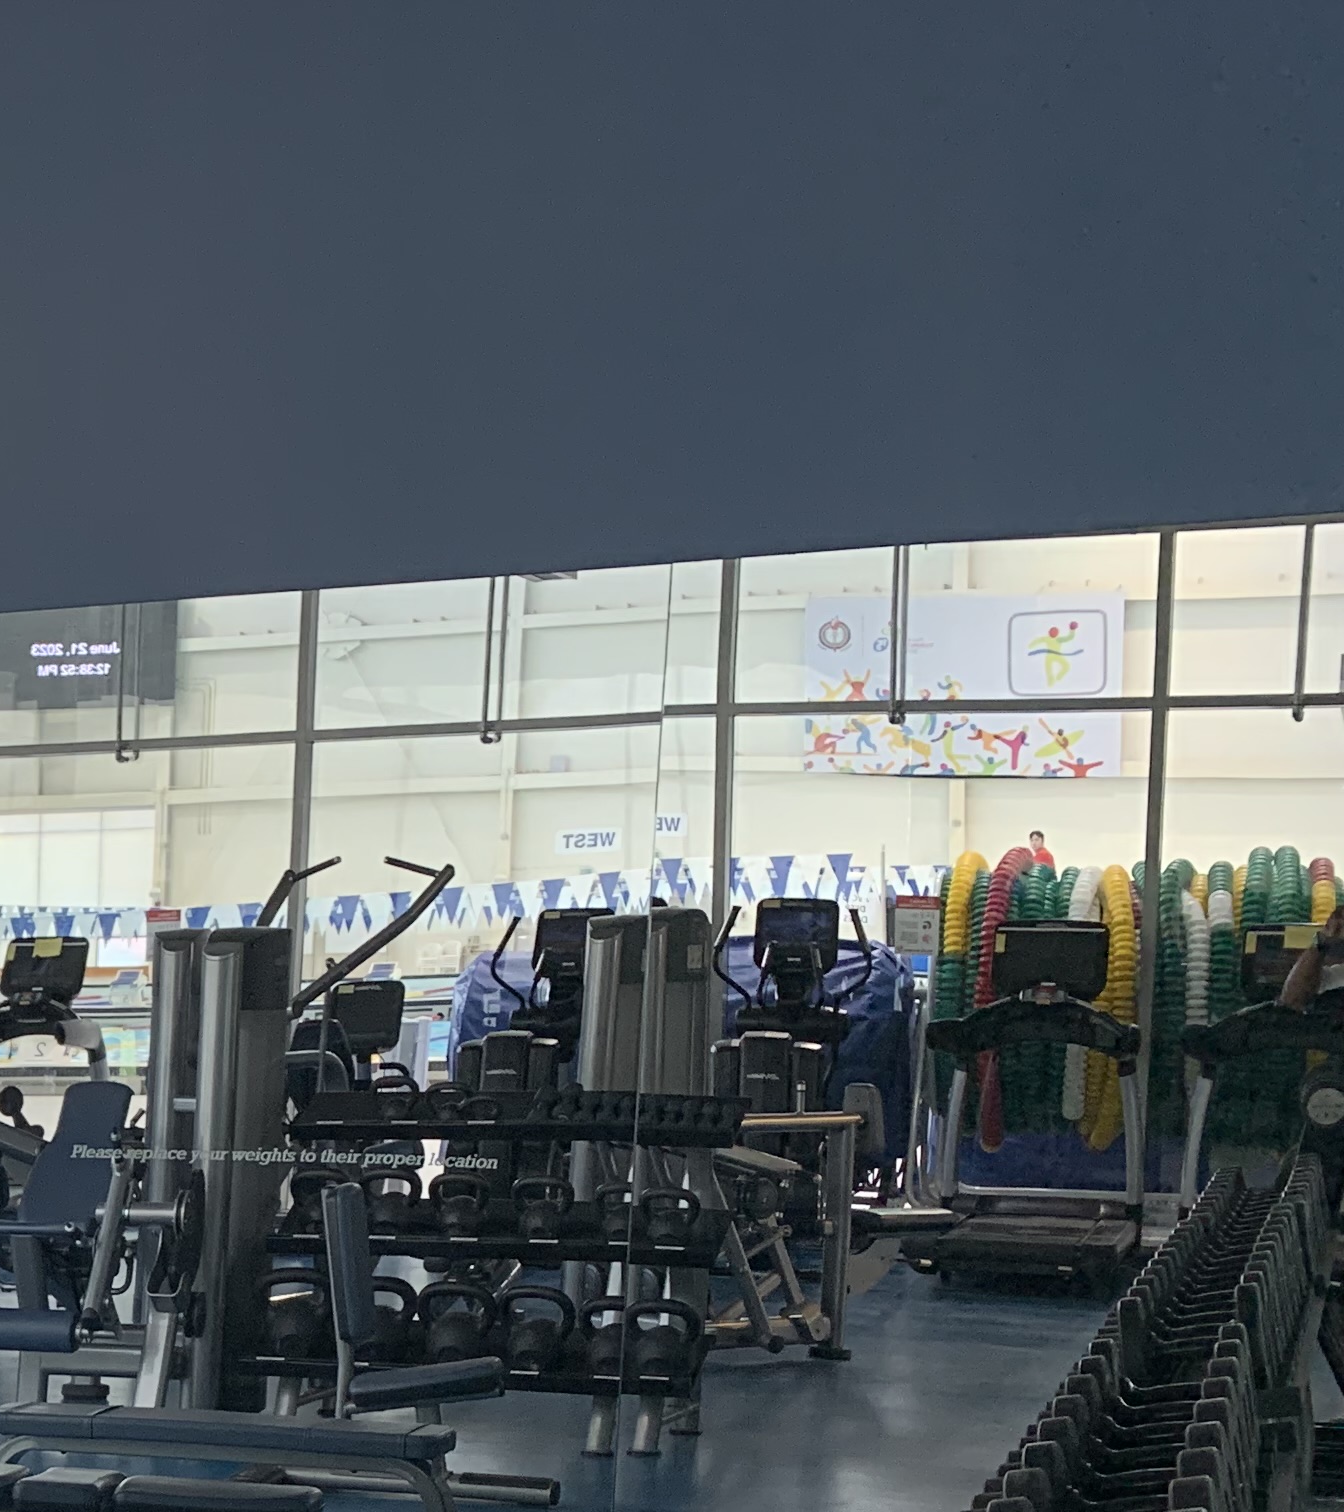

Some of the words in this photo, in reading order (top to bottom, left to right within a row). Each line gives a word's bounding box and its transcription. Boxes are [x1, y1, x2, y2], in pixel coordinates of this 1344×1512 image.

[70, 1144, 122, 1160] Please
[124, 1147, 188, 1164] replace
[231, 1147, 297, 1166] weights
[300, 1149, 317, 1163] to
[320, 1148, 361, 1164] their
[361, 1151, 425, 1169] proper
